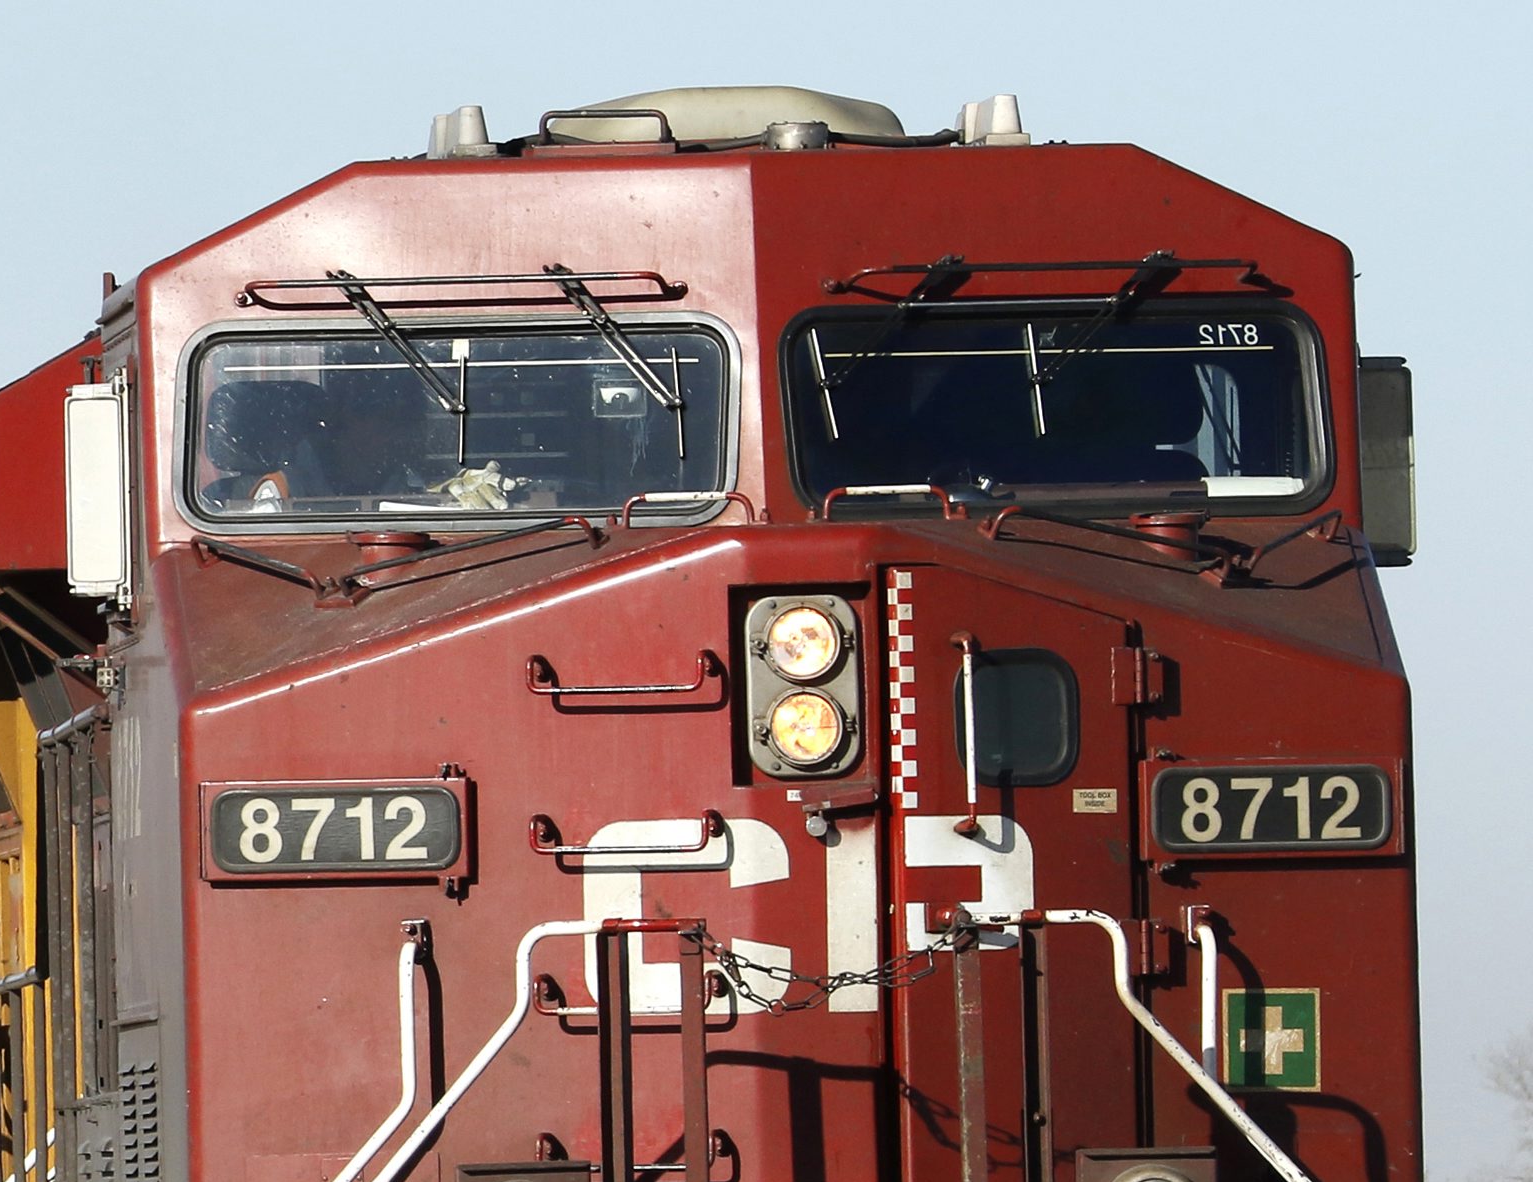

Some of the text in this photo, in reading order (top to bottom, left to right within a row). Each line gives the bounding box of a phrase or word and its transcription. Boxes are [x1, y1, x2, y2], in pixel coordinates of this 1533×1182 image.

[239, 796, 428, 863] 8712
[1181, 775, 1362, 842] 8712
[583, 815, 1034, 1014] CP
